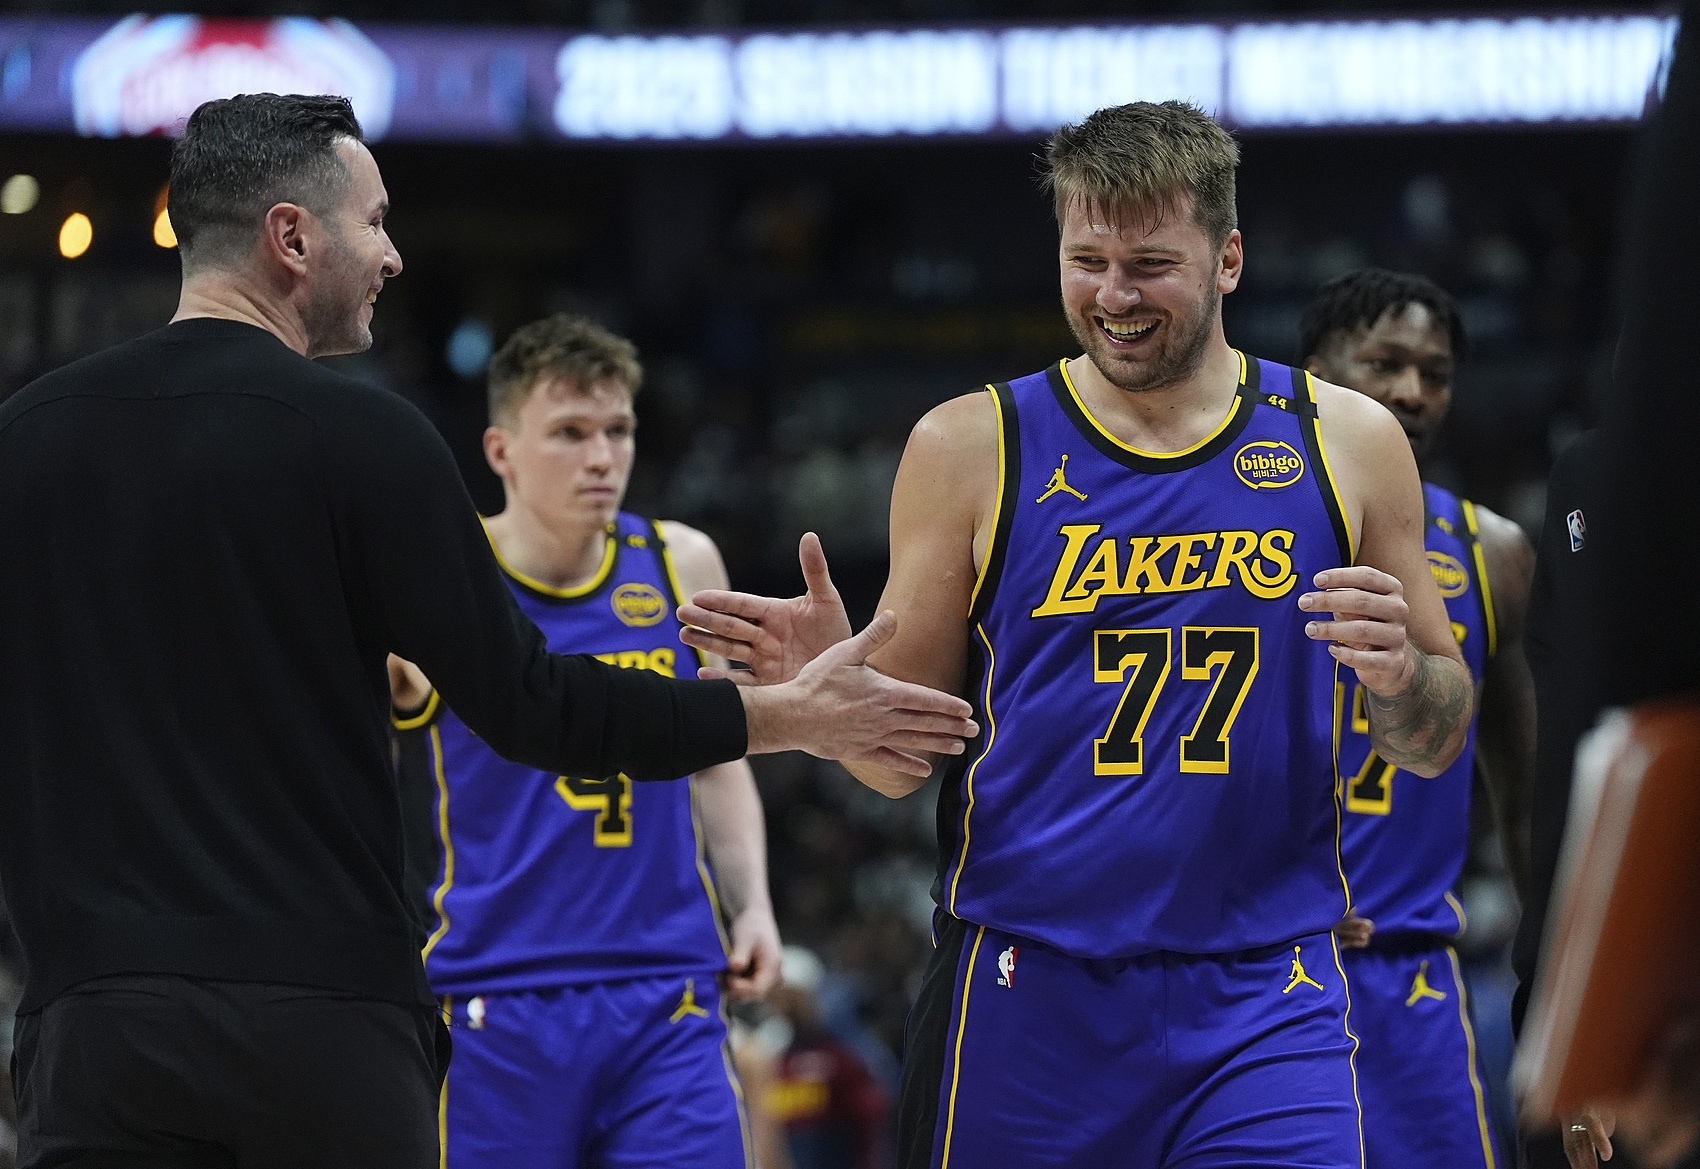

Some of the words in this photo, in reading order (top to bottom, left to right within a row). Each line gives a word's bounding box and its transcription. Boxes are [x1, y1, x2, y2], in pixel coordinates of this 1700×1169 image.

[1268, 395, 1287, 410] 44
[1240, 453, 1300, 474] bibigo
[1031, 523, 1298, 619] LAKERS
[1093, 626, 1260, 777] 77
